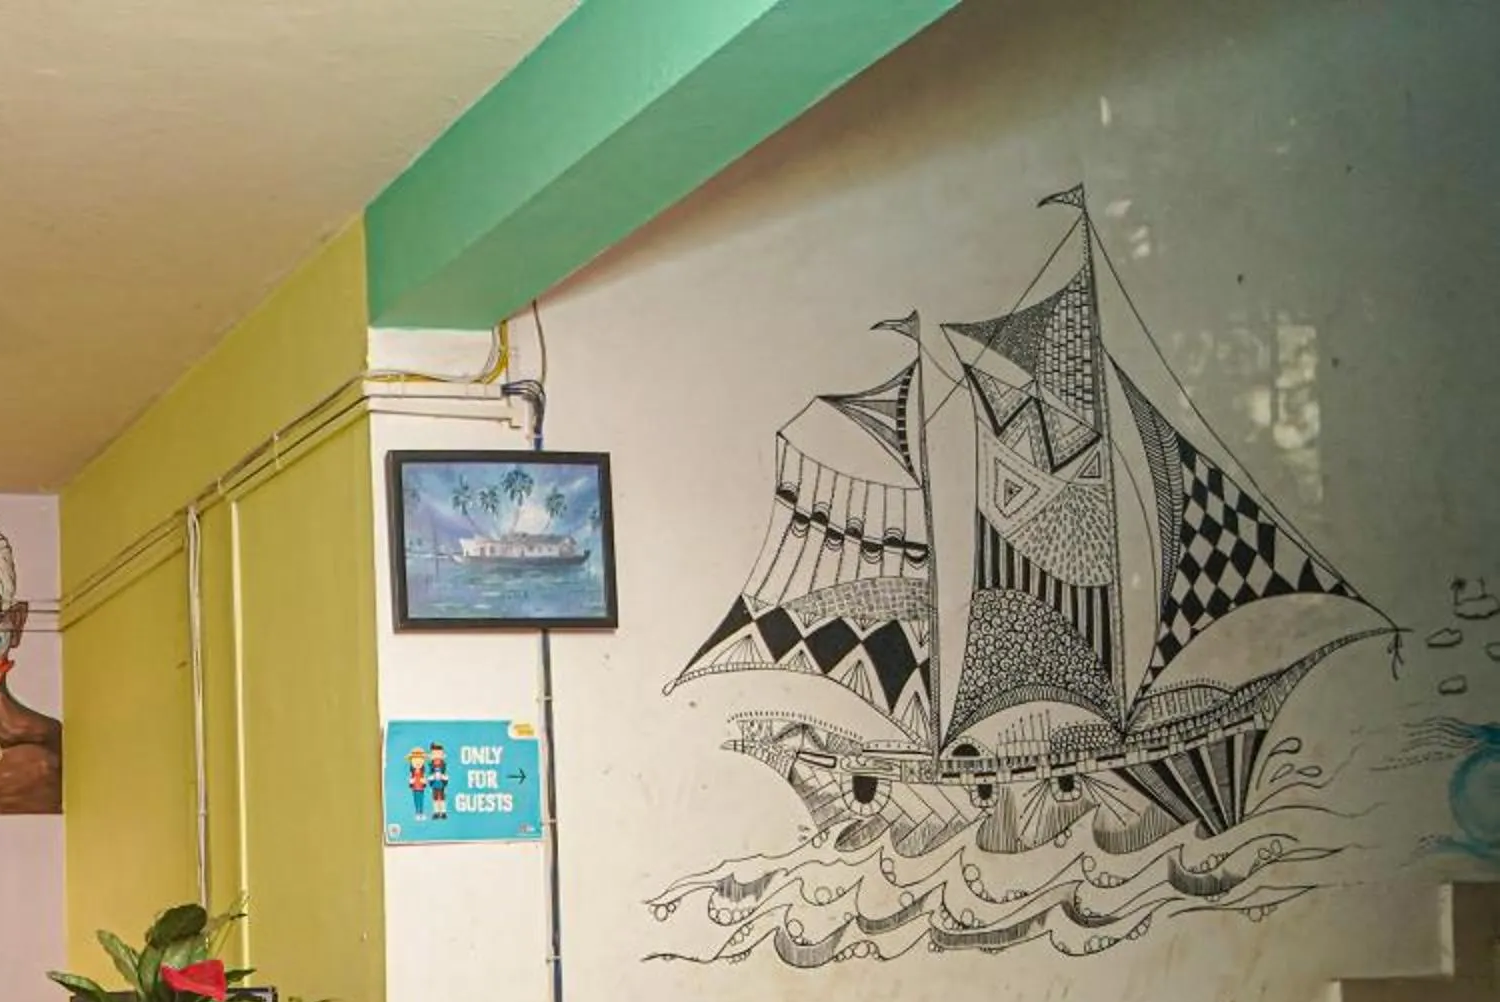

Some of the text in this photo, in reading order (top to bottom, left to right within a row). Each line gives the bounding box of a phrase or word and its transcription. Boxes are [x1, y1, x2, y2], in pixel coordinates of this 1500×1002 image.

[460, 746, 503, 765] ONLY
[467, 769, 498, 789] FOR
[455, 793, 513, 812] GUESTS
